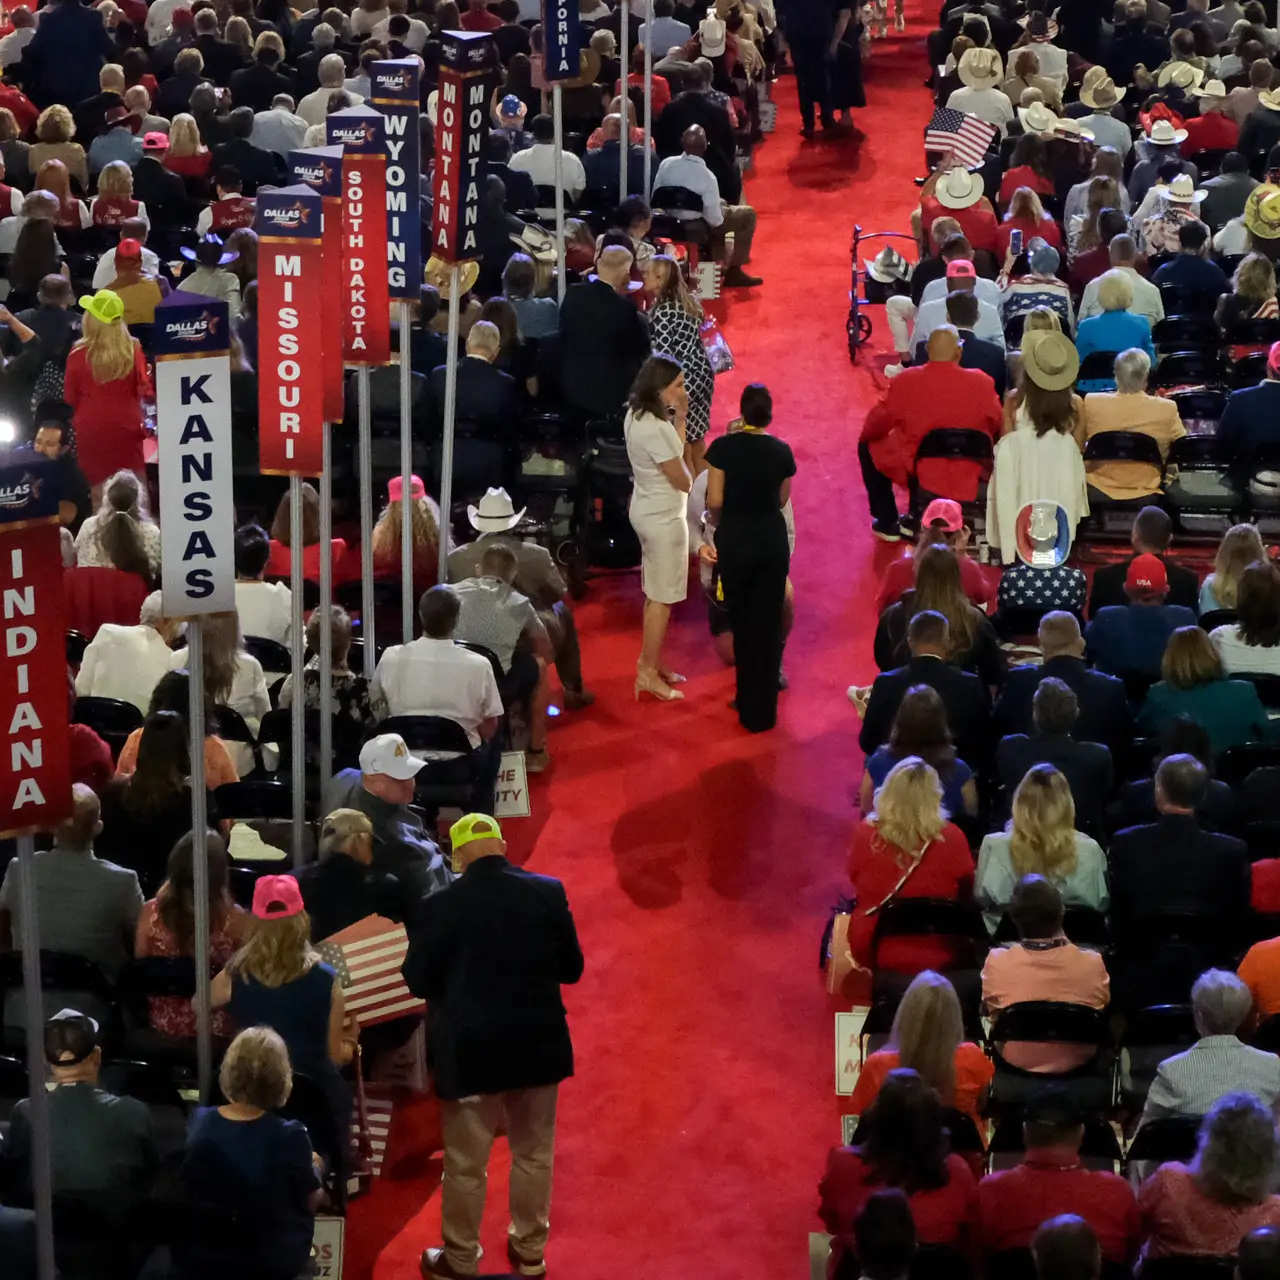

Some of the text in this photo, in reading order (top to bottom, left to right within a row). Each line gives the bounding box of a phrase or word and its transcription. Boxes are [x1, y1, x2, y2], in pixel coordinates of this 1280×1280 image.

[332, 128, 366, 138] DALLAS
[376, 75, 404, 84] DALLAS
[263, 208, 300, 219] DALLAS
[294, 165, 324, 177] DALLAS
[384, 115, 408, 288] WYOMING
[437, 81, 457, 249] MONTANA
[464, 84, 484, 250] MONTANA
[166, 319, 208, 333] DALLAS
[348, 170, 367, 350] SOUTH DAKOTA
[275, 255, 301, 460] MISSOURI
[178, 374, 217, 599] KANSAS
[3, 548, 46, 811] INDIANA
